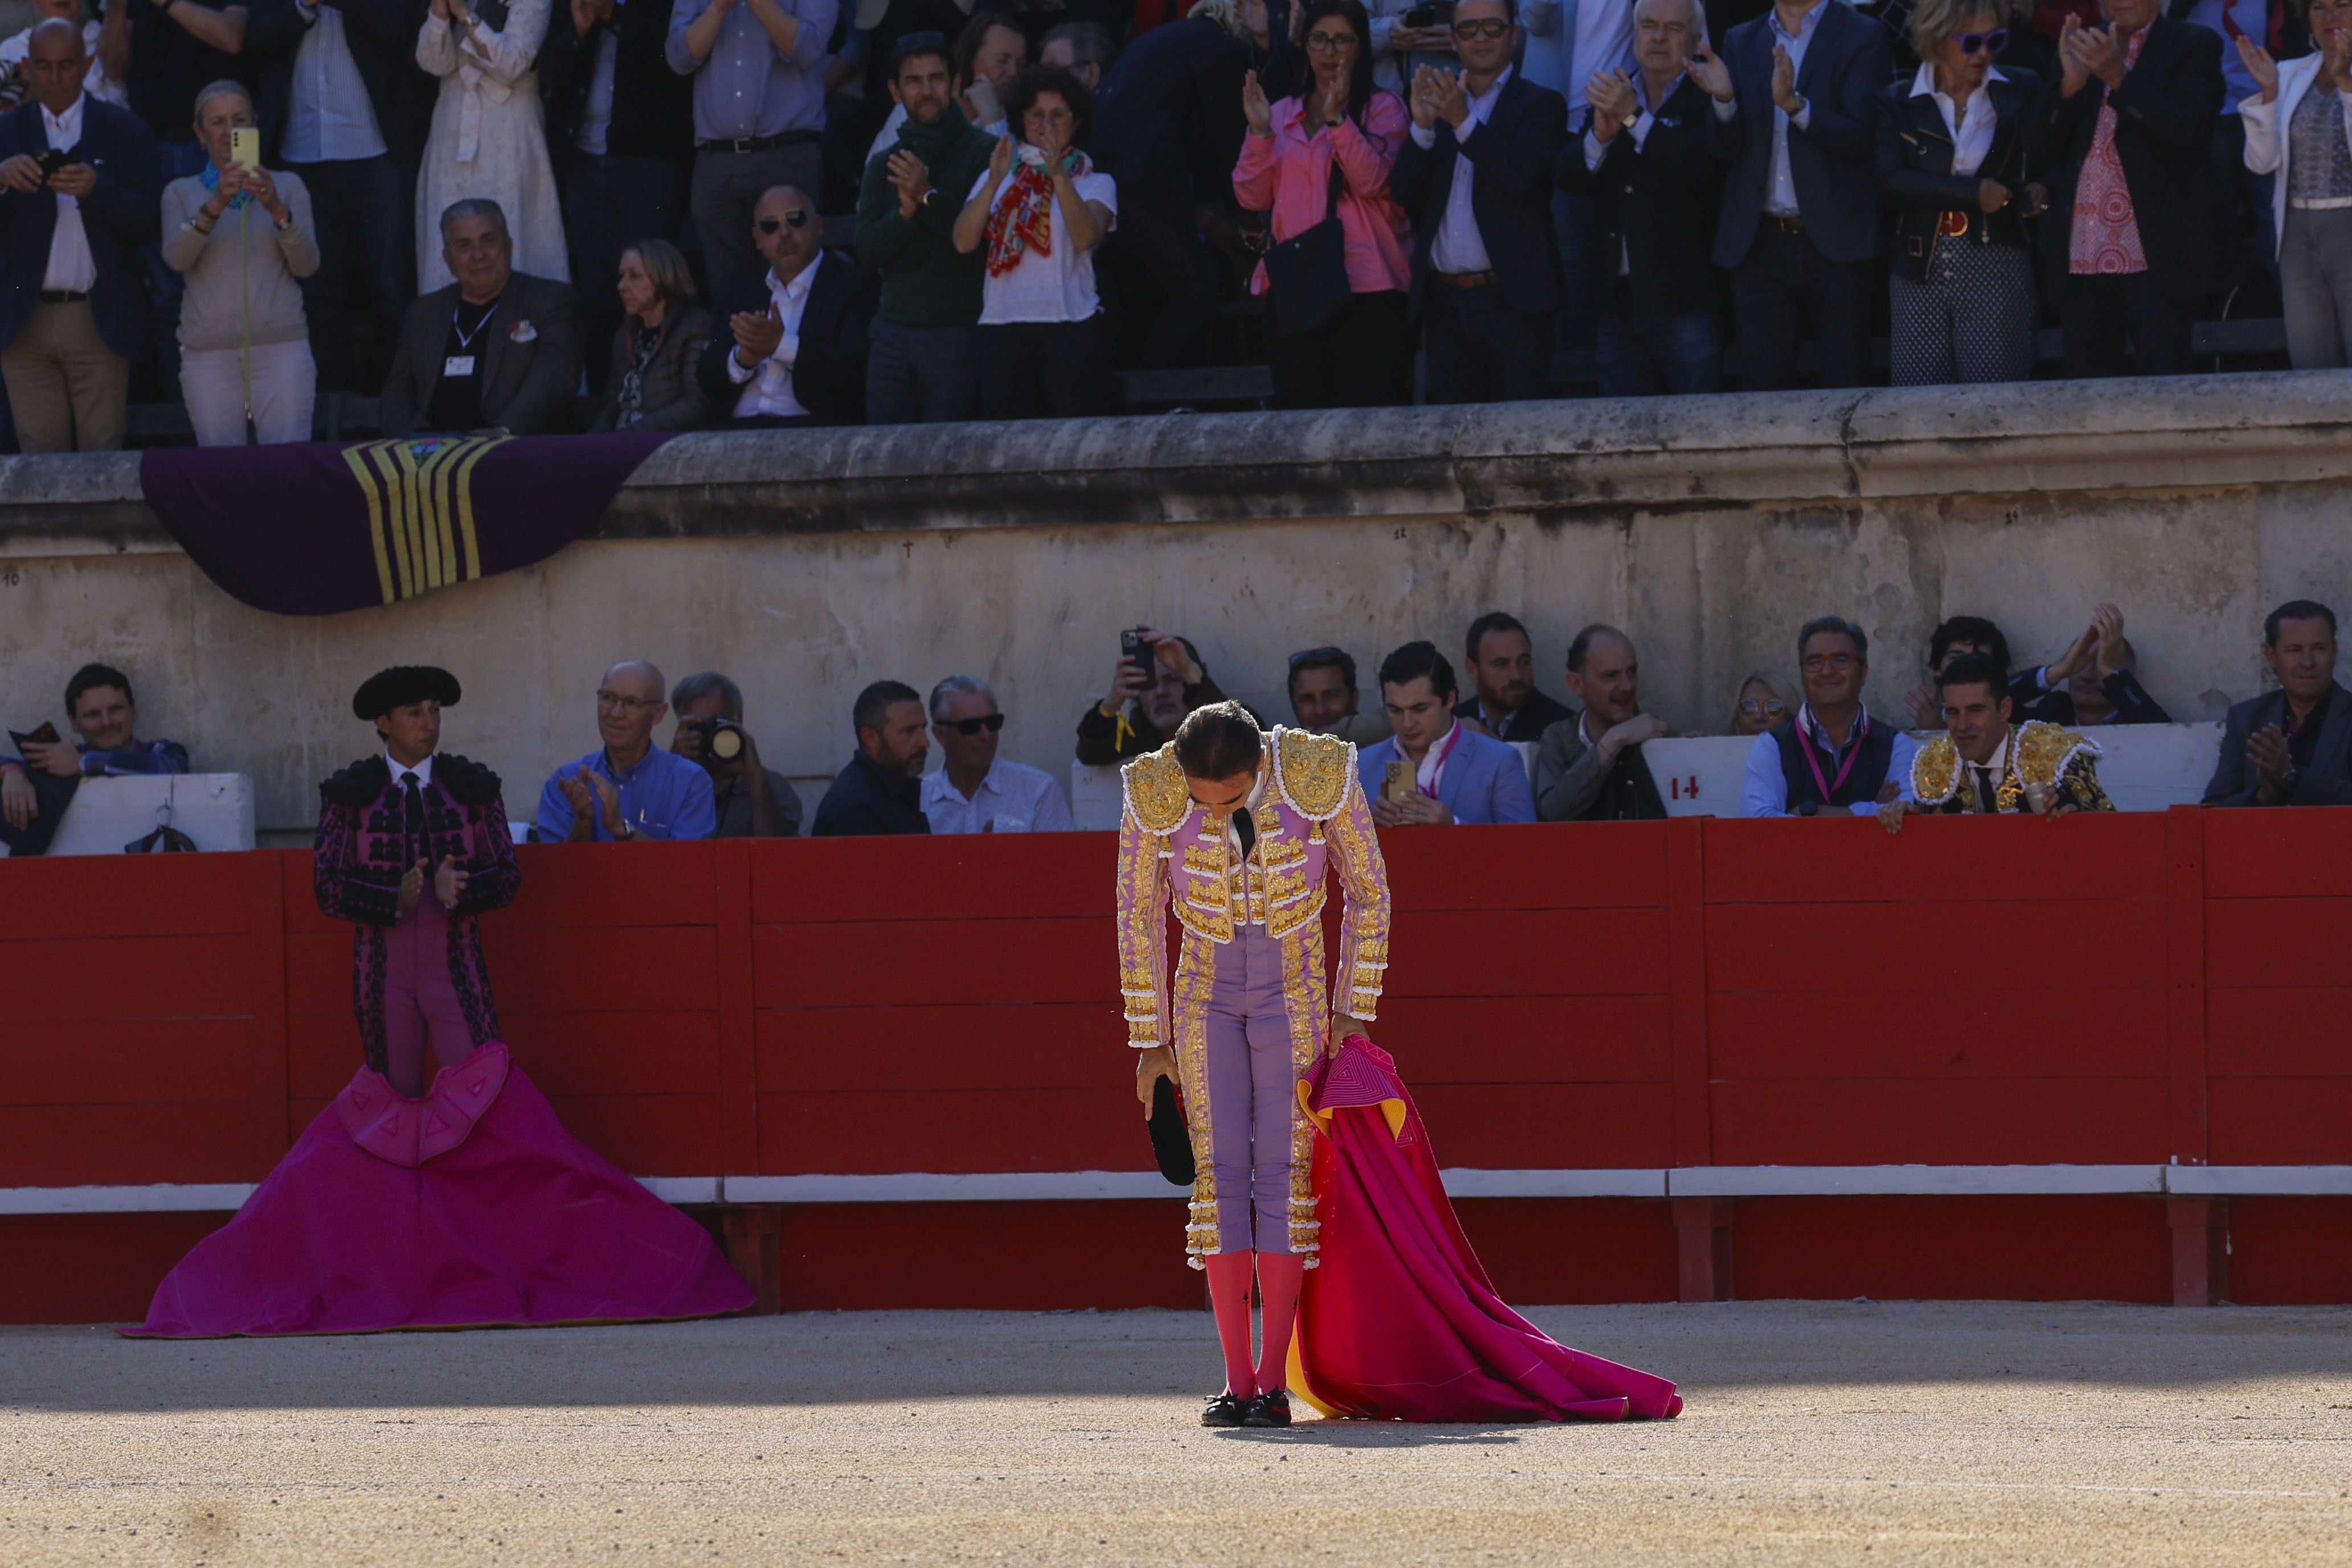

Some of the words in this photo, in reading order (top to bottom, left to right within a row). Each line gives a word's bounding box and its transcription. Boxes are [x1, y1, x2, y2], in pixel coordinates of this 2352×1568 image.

[1394, 527, 1407, 540] 12
[3, 573, 19, 587] 10
[1672, 776, 1699, 800] 14
